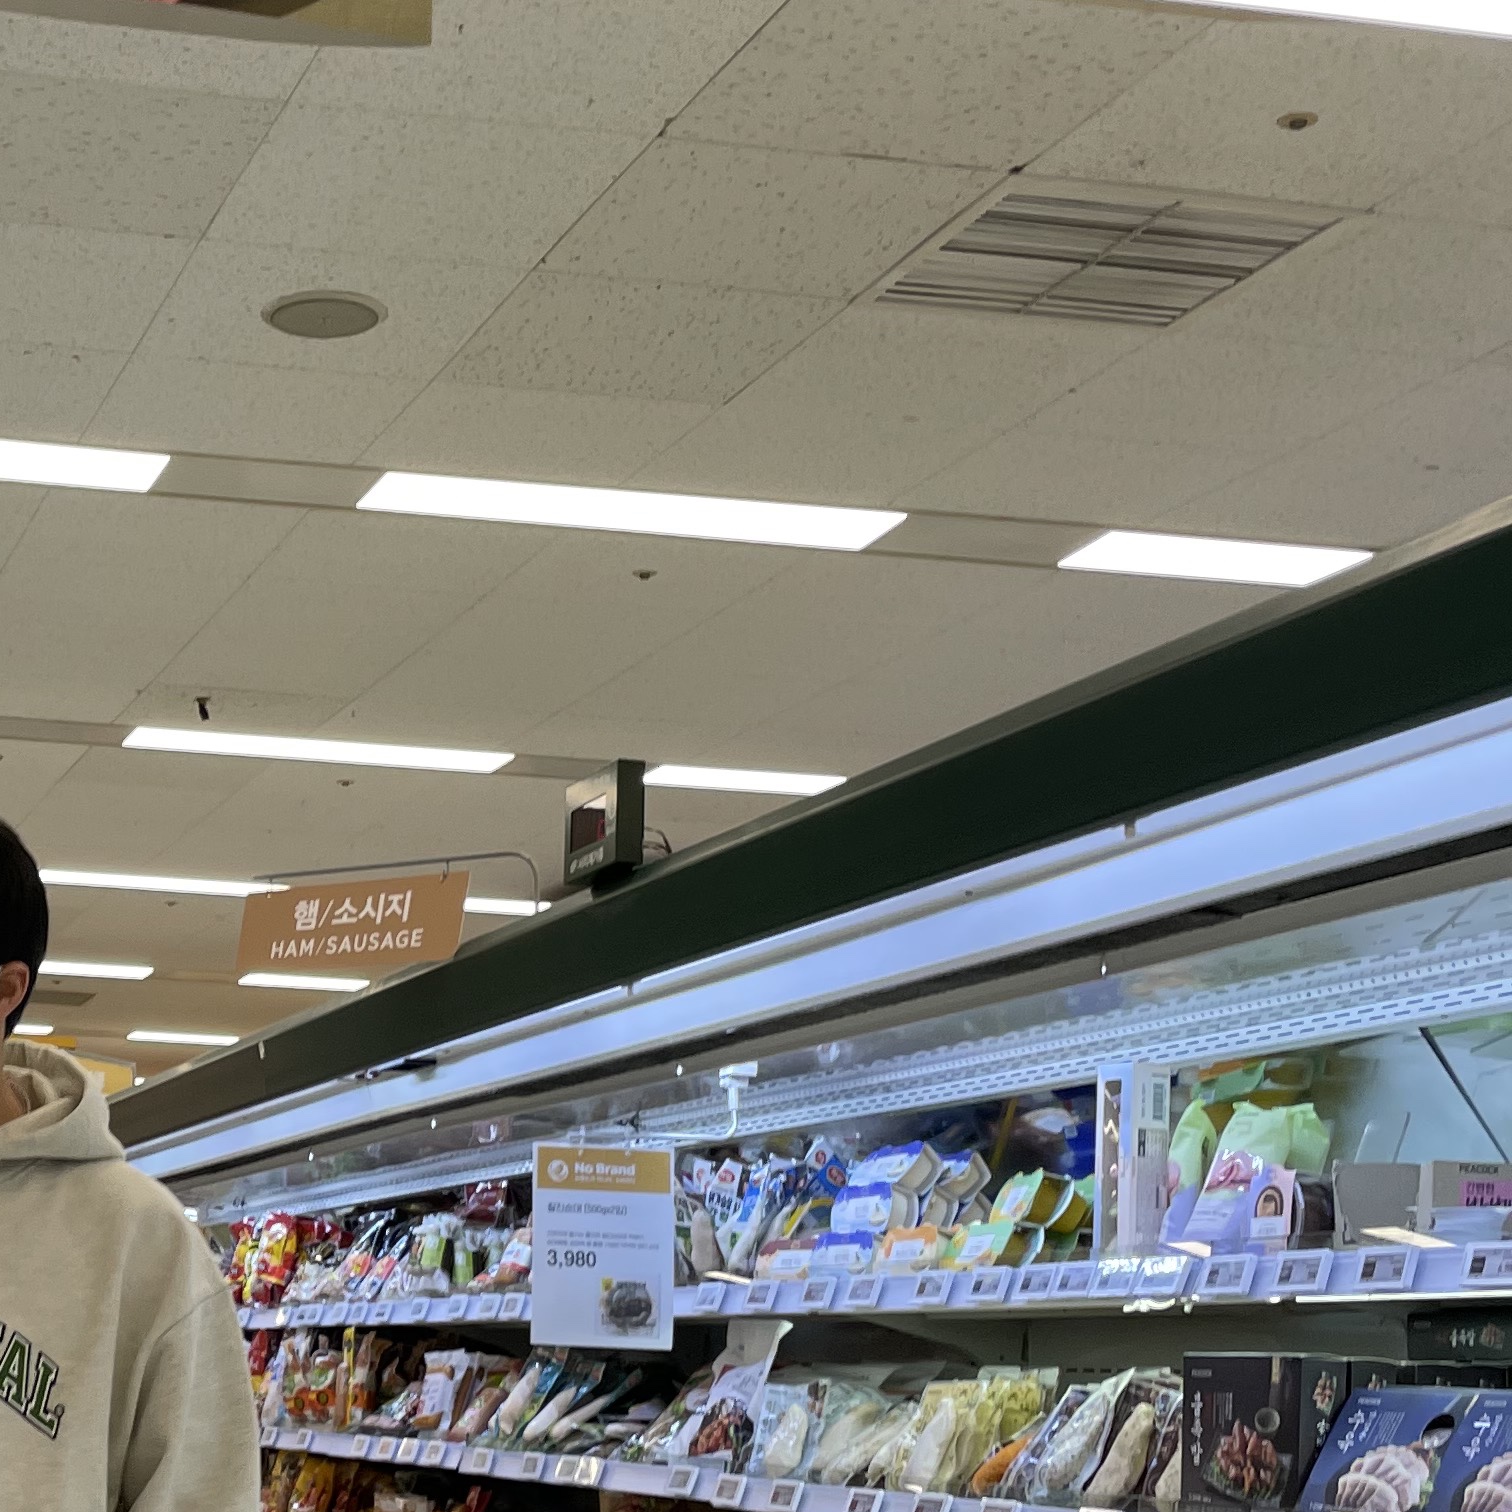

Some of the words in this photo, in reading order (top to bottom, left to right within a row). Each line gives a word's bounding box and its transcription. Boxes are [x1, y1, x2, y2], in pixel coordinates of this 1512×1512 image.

[294, 889, 413, 931] 햄/소시지
[270, 928, 424, 959] HAM/SAUSAGE
[575, 1162, 591, 1174] No
[595, 1163, 636, 1176] Brand
[547, 1249, 596, 1267] 3,980
